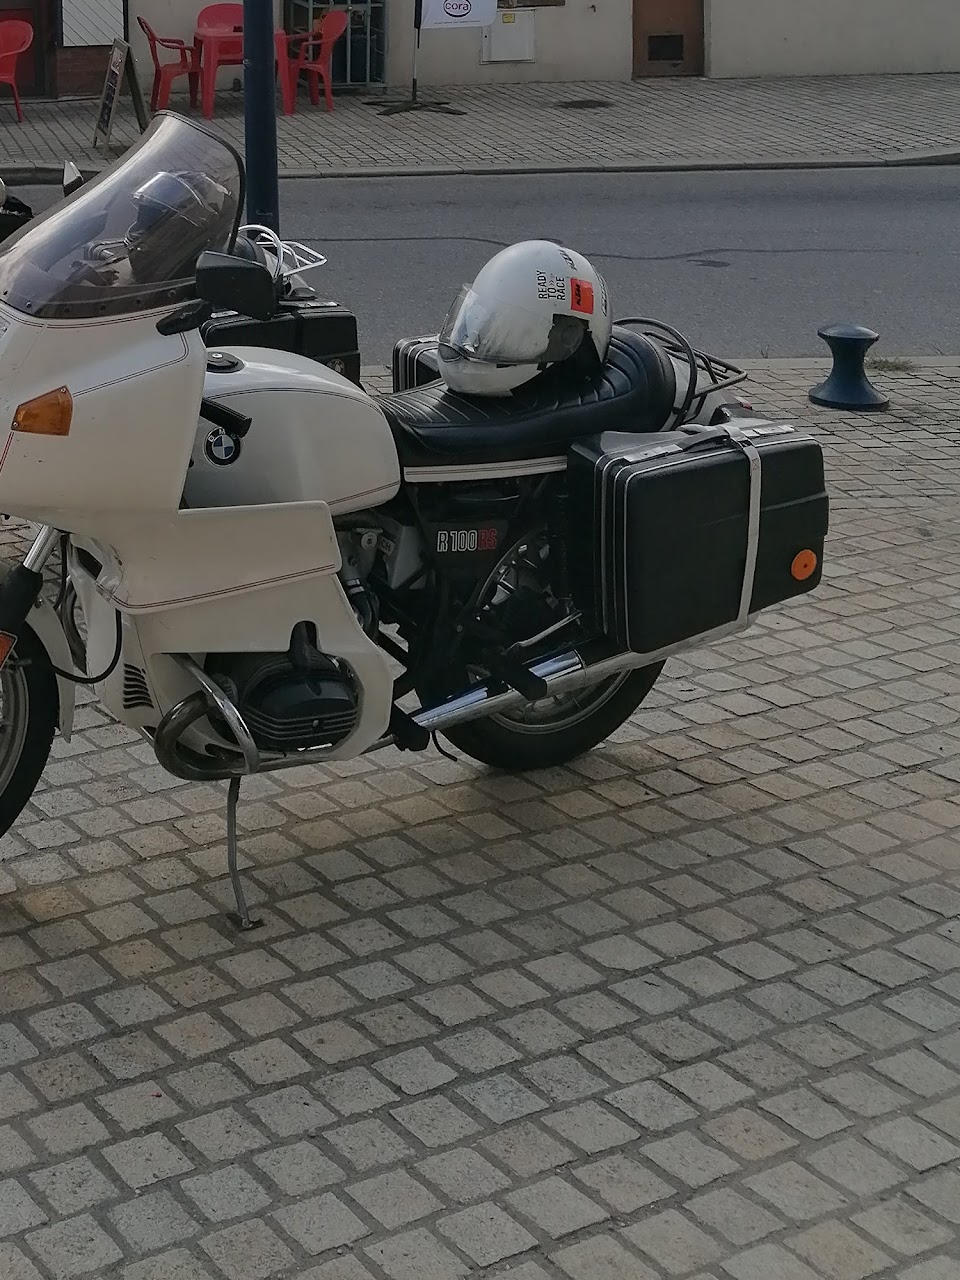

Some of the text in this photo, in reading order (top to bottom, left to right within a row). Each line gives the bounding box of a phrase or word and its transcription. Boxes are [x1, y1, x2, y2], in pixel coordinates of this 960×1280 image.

[445, 2, 469, 10] cora
[536, 270, 548, 299] READY
[548, 287, 557, 299] TO
[556, 276, 566, 300] RACE
